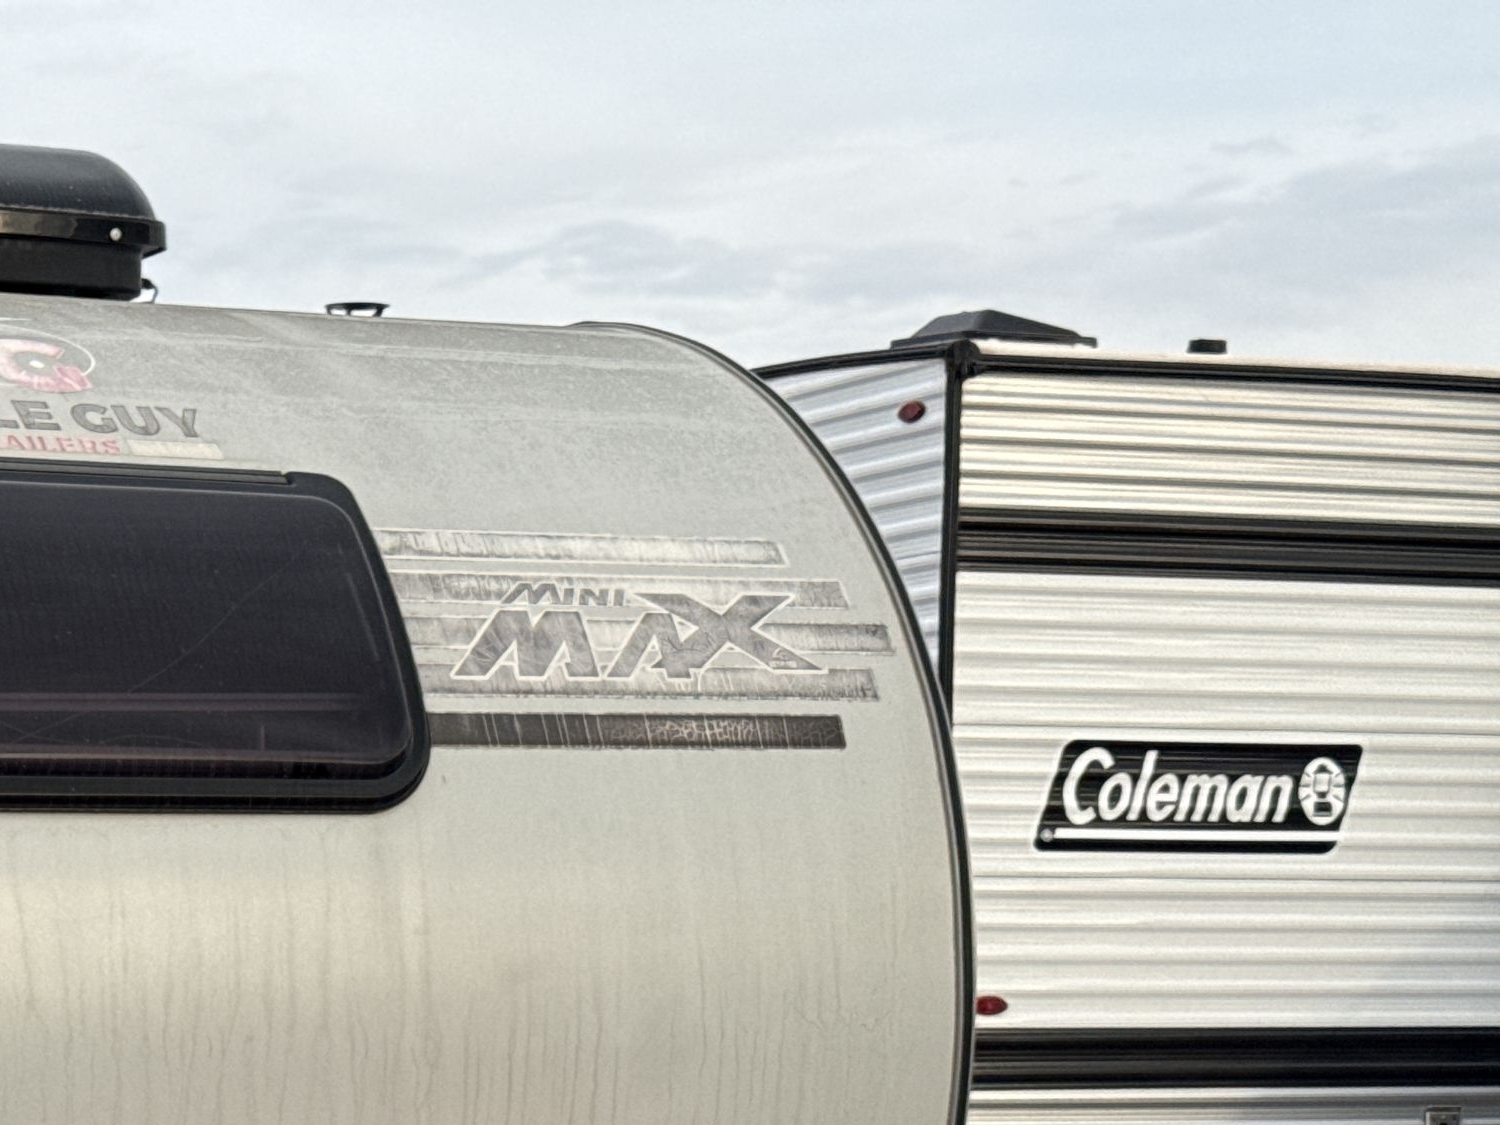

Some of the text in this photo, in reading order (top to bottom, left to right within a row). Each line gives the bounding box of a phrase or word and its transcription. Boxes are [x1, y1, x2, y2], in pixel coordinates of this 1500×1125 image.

[70, 403, 200, 438] GUY
[449, 592, 829, 681] MAX
[1062, 747, 1295, 826] Coleman
